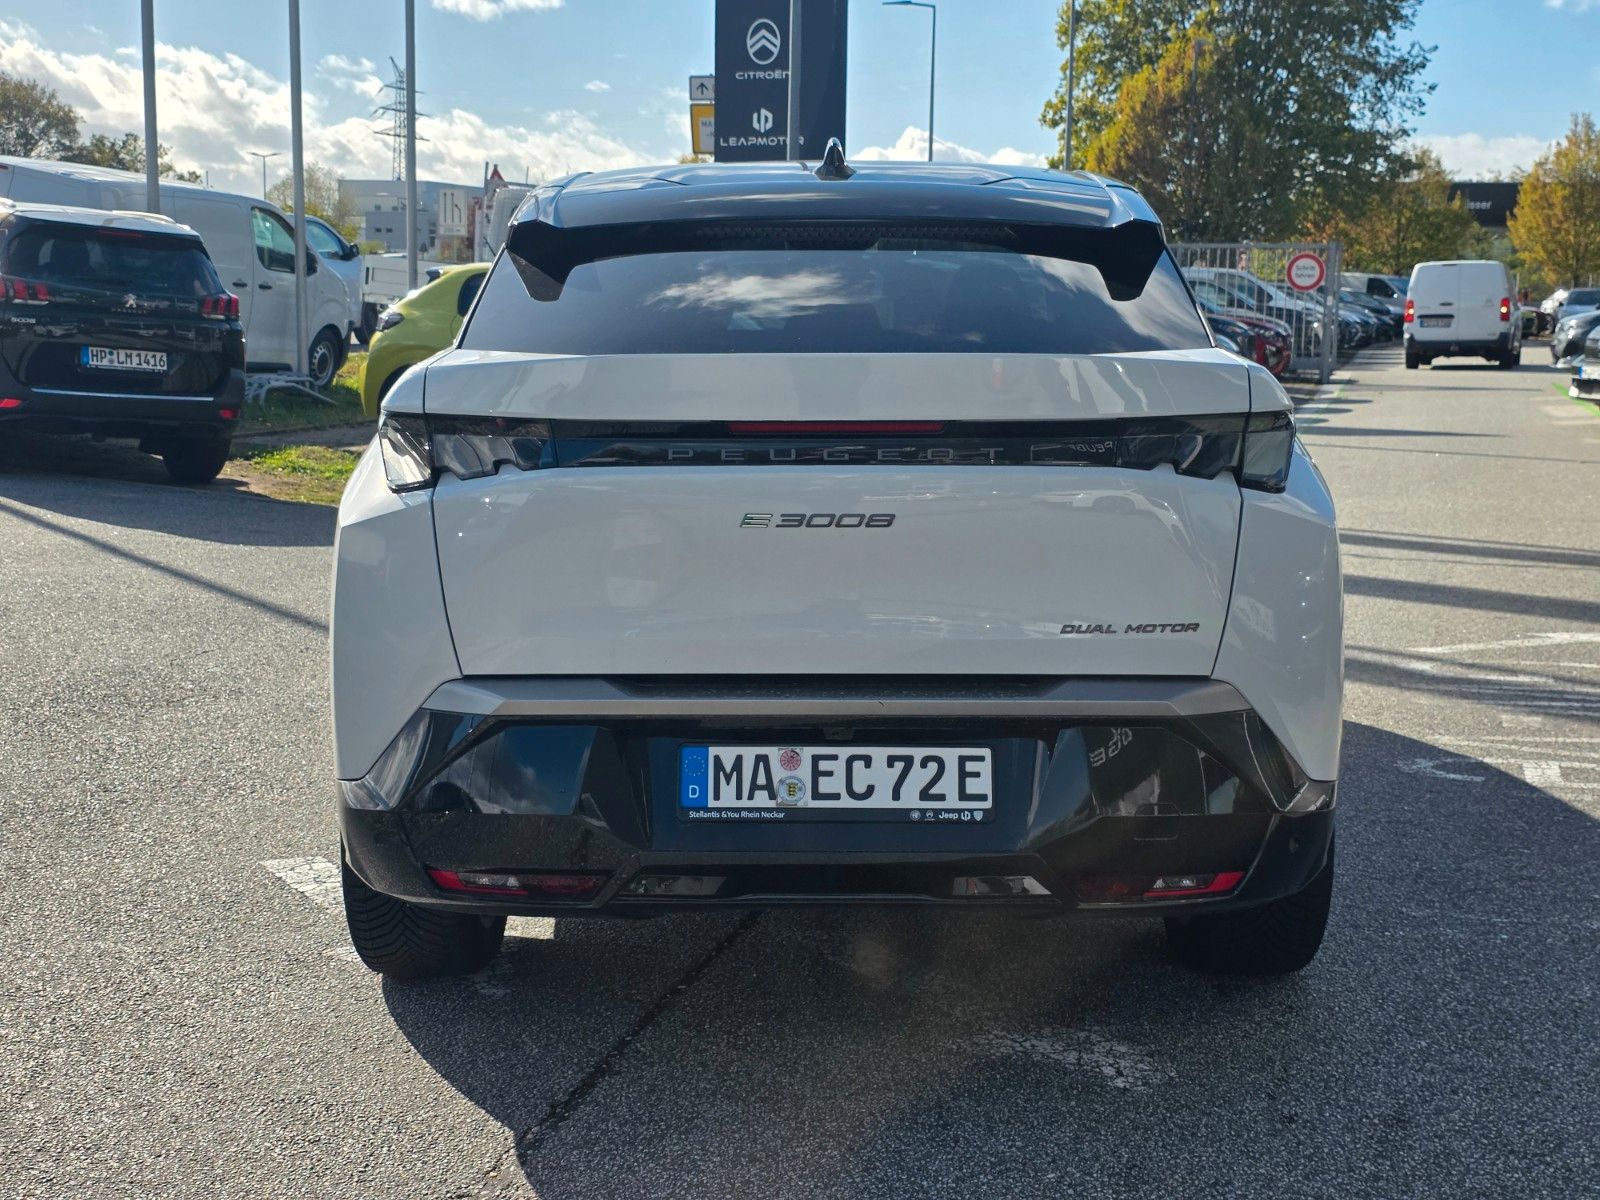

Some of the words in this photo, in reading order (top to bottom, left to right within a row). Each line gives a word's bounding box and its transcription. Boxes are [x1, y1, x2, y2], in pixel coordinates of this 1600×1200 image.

[720, 136, 804, 147] LEAPMOTR
[91, 349, 107, 363] HP
[117, 352, 133, 365] LM
[136, 353, 166, 368] 1416
[667, 448, 1004, 461] PEUGEOT
[1060, 624, 1117, 634] DUAL
[1124, 622, 1200, 633] MOTOR
[713, 754, 778, 801] MA
[938, 811, 959, 819] Jeep
